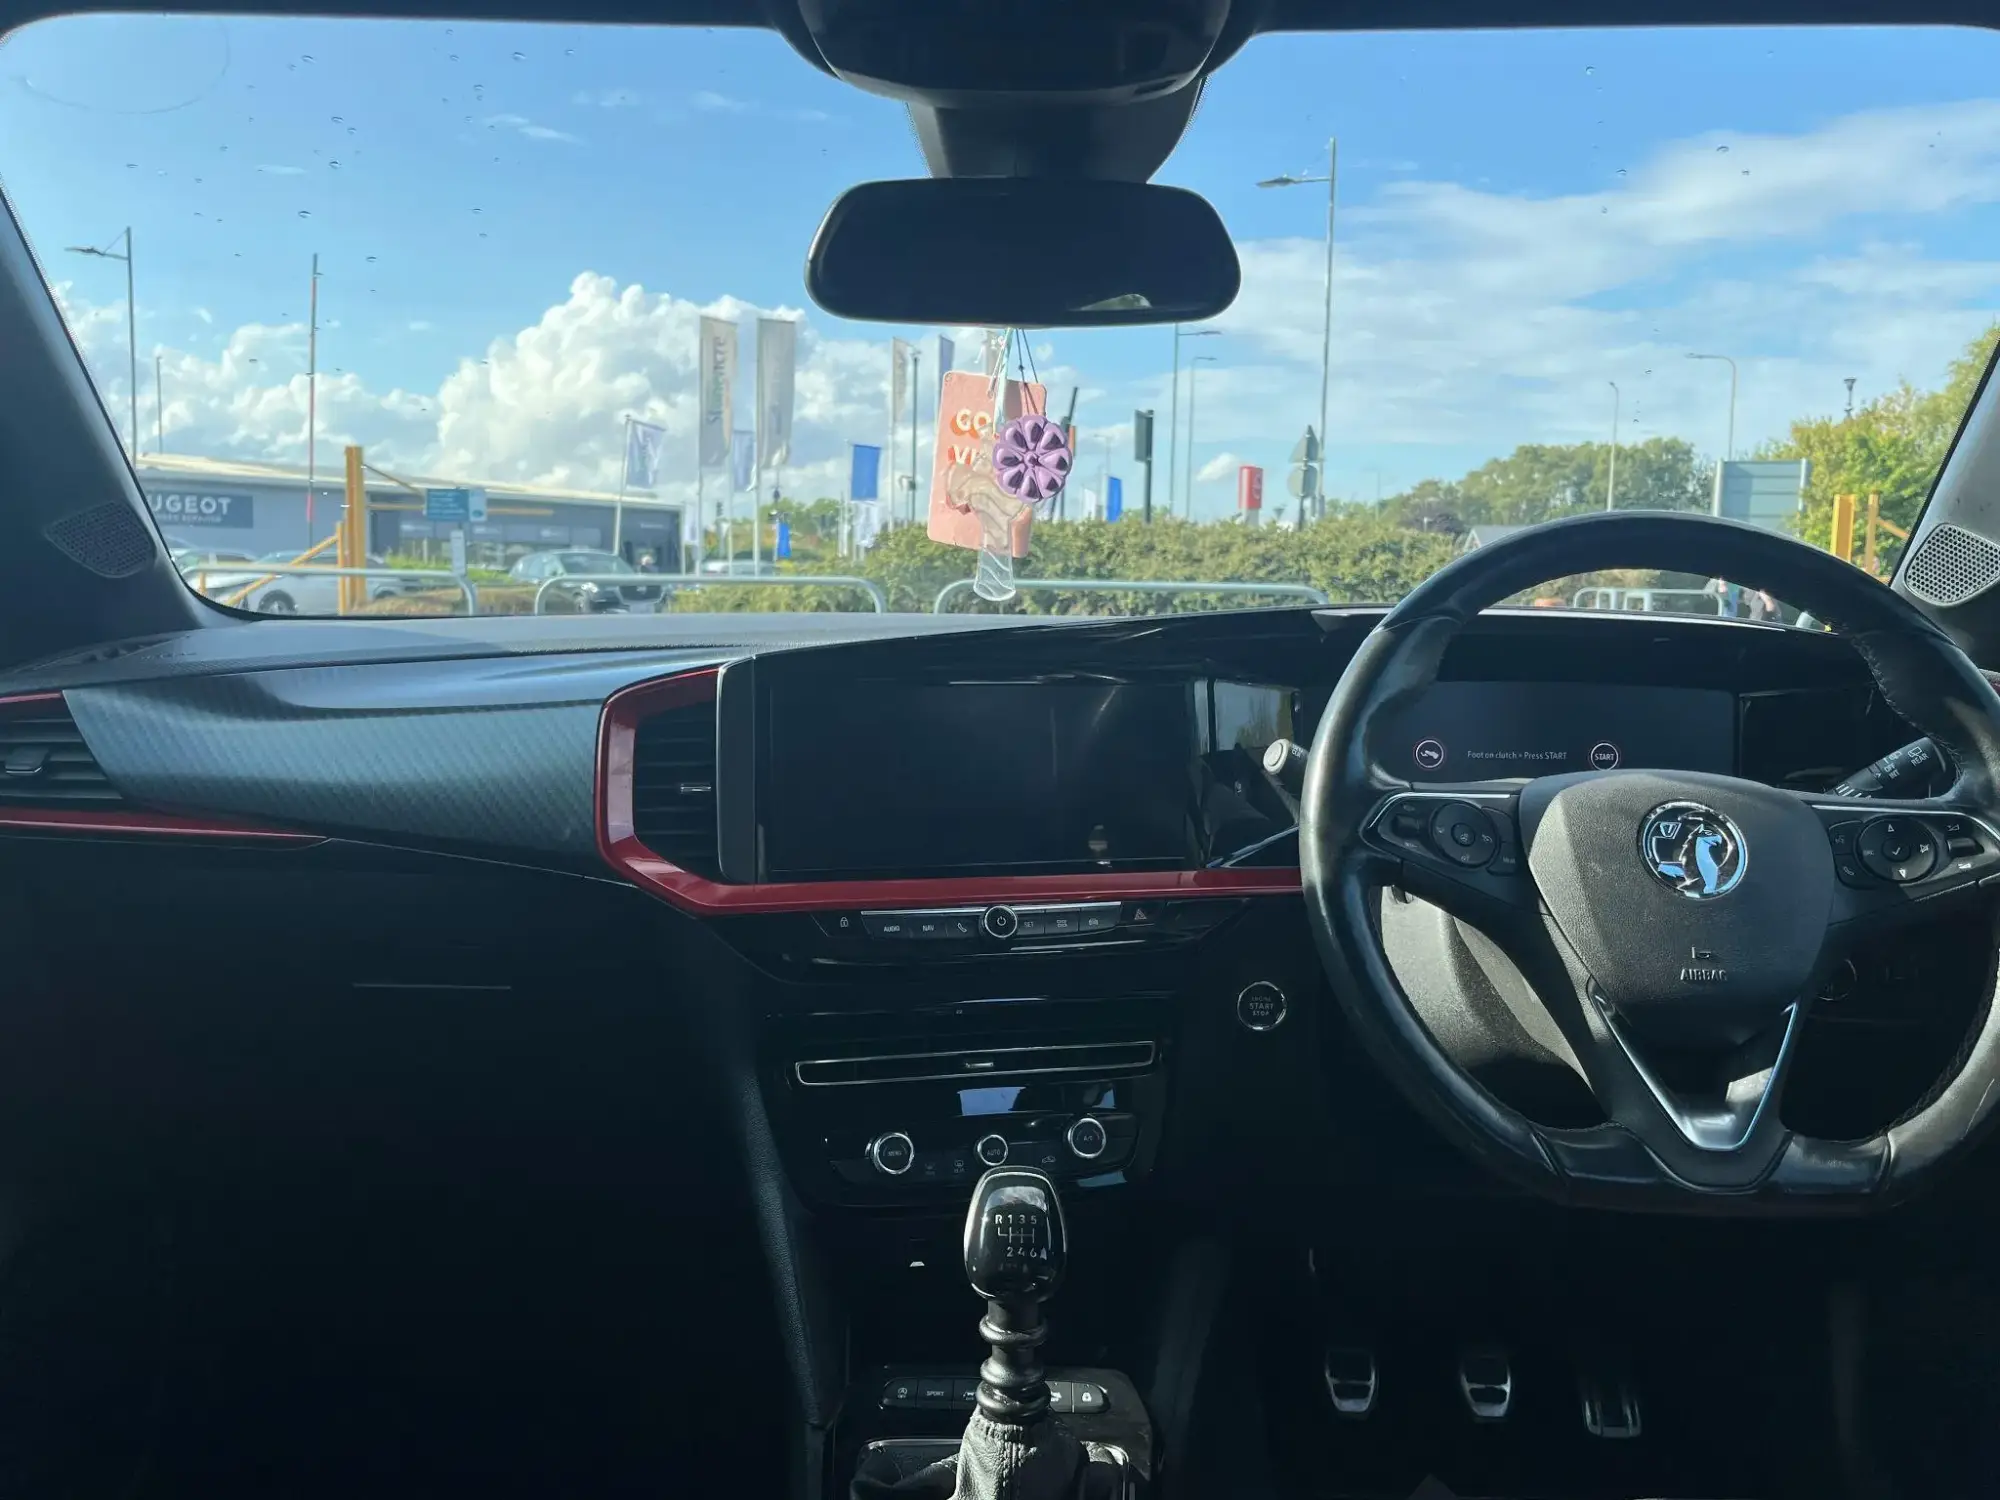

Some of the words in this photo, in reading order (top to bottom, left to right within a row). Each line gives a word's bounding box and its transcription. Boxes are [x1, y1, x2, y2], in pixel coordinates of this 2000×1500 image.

[951, 408, 992, 438] GO
[148, 493, 232, 515] UGEOT
[1467, 750, 1484, 759] Foot
[1495, 751, 1518, 760] clutch
[1524, 751, 1544, 760] Press
[1544, 751, 1567, 760] START
[1594, 753, 1615, 761] START
[1911, 753, 1930, 767] REAR
[1884, 763, 1896, 773] OFF
[883, 925, 900, 933] AUDIO
[922, 924, 935, 932] NAV
[1680, 968, 1727, 981] AIRBAG
[1249, 1002, 1274, 1010] START
